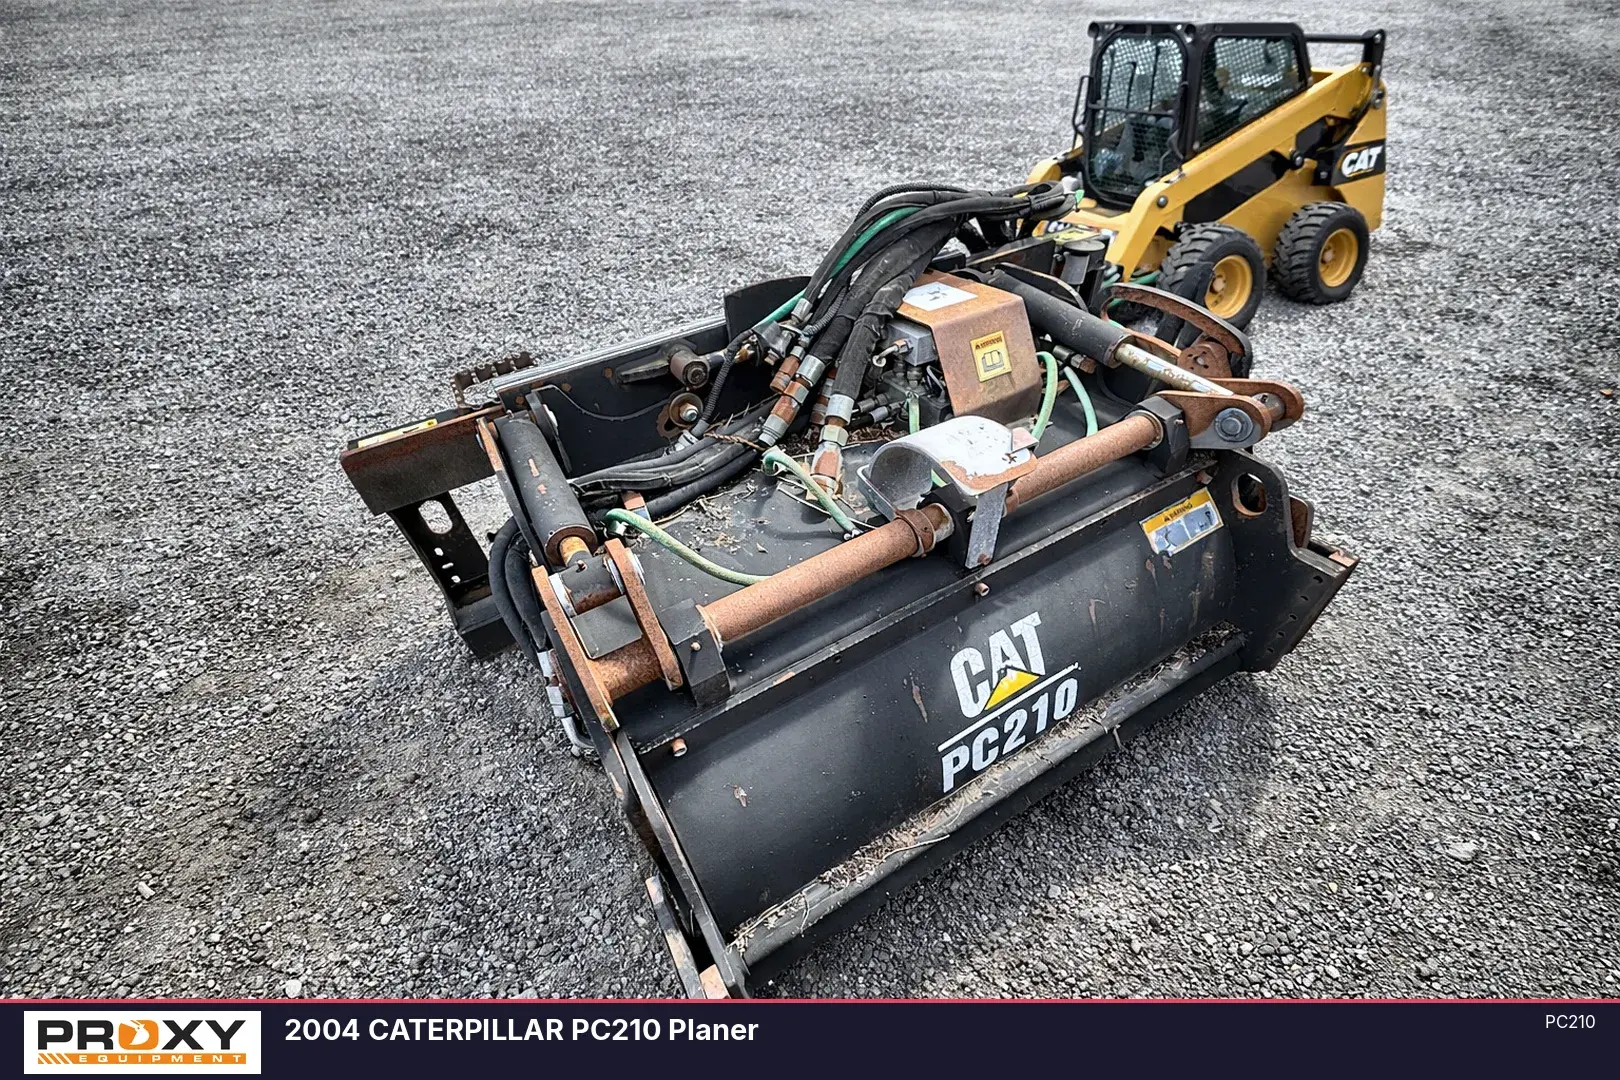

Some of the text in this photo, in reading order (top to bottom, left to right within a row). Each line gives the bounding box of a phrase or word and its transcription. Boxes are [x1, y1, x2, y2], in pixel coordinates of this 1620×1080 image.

[1341, 145, 1383, 177] CAT
[950, 611, 1046, 719] CAT
[942, 677, 1079, 793] PC210
